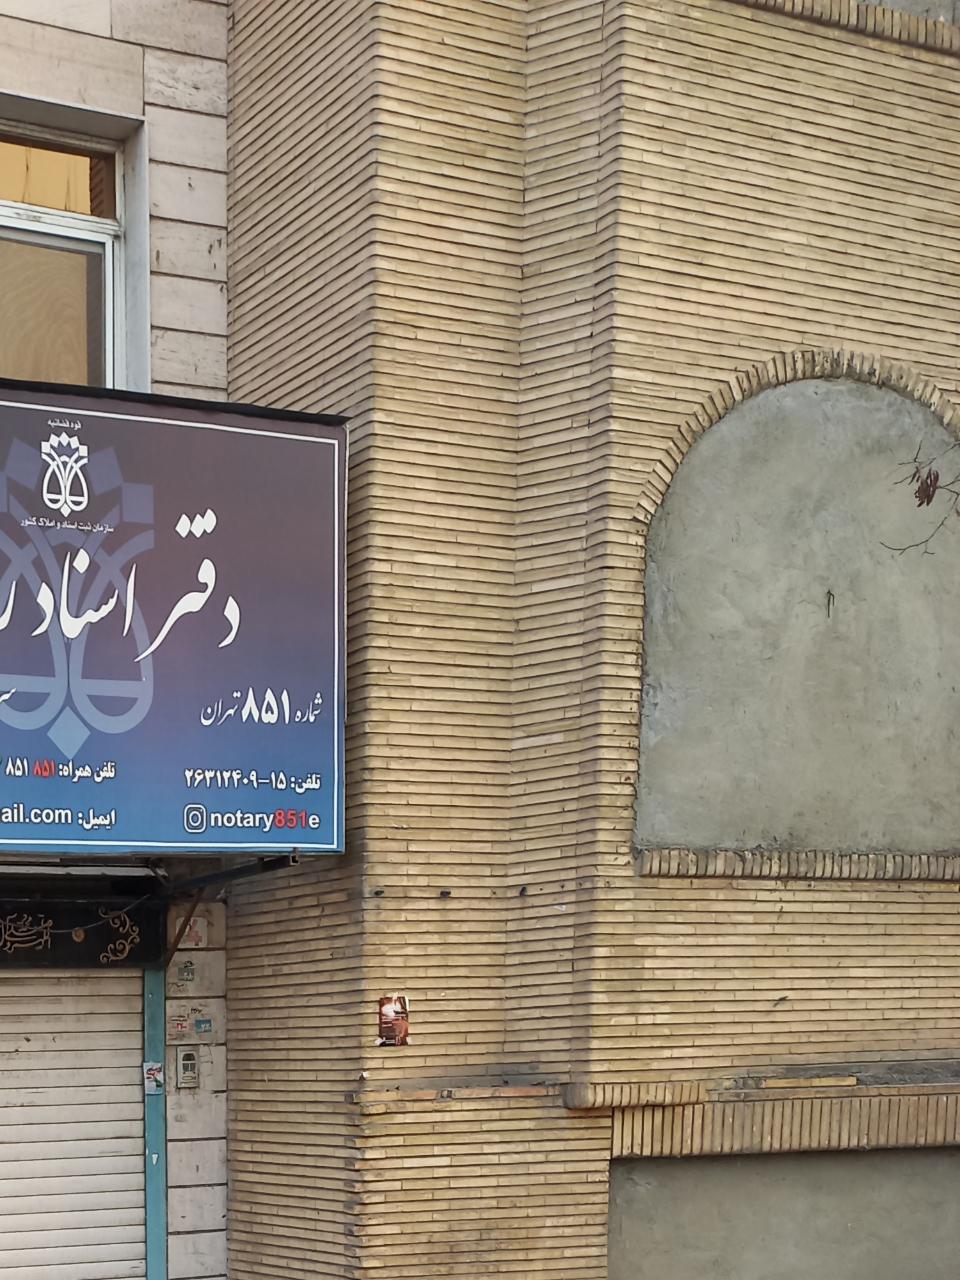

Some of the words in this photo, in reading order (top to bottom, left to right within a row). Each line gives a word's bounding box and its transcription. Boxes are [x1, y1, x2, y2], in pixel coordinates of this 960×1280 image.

[31, 548, 136, 640] اسناد
[135, 508, 241, 662] دفتر
[200, 691, 241, 726] تهران
[241, 687, 291, 725] ۸۵۱
[294, 692, 323, 723] شماره
[5, 757, 29, 777] ۸۵۱
[33, 758, 56, 778] ۸۵۱
[93, 760, 116, 784] تلفن
[210, 808, 321, 833] notary851e
